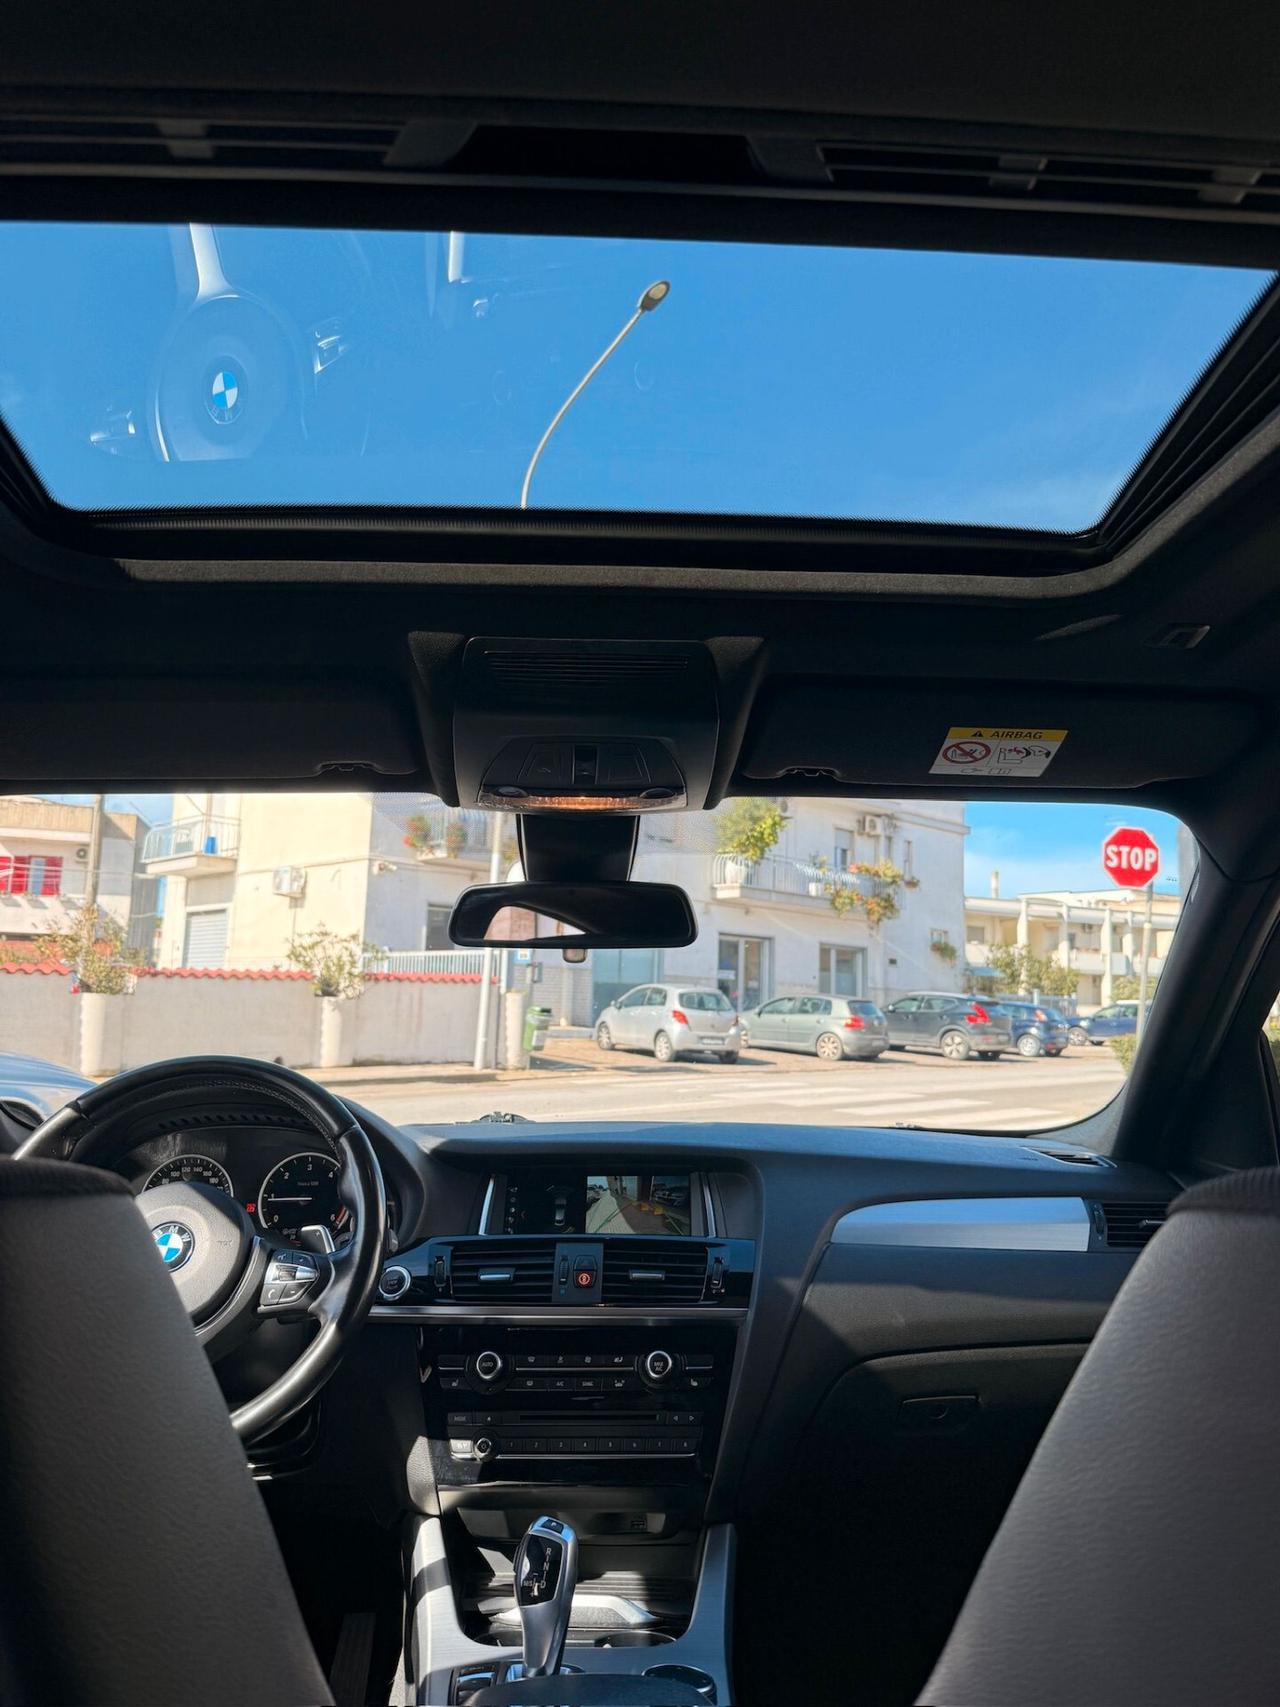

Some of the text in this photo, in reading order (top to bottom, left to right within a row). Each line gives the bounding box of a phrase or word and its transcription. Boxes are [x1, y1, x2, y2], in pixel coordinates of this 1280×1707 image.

[989, 730, 1043, 740] AIRBAG
[1106, 844, 1157, 871] STOP
[307, 1163, 313, 1171] 3
[284, 1172, 290, 1180] 2
[328, 1171, 334, 1179] 4
[330, 1213, 336, 1221] 6
[546, 1547, 552, 1556] R
[543, 1562, 550, 1571] N
[540, 1580, 547, 1589] D
